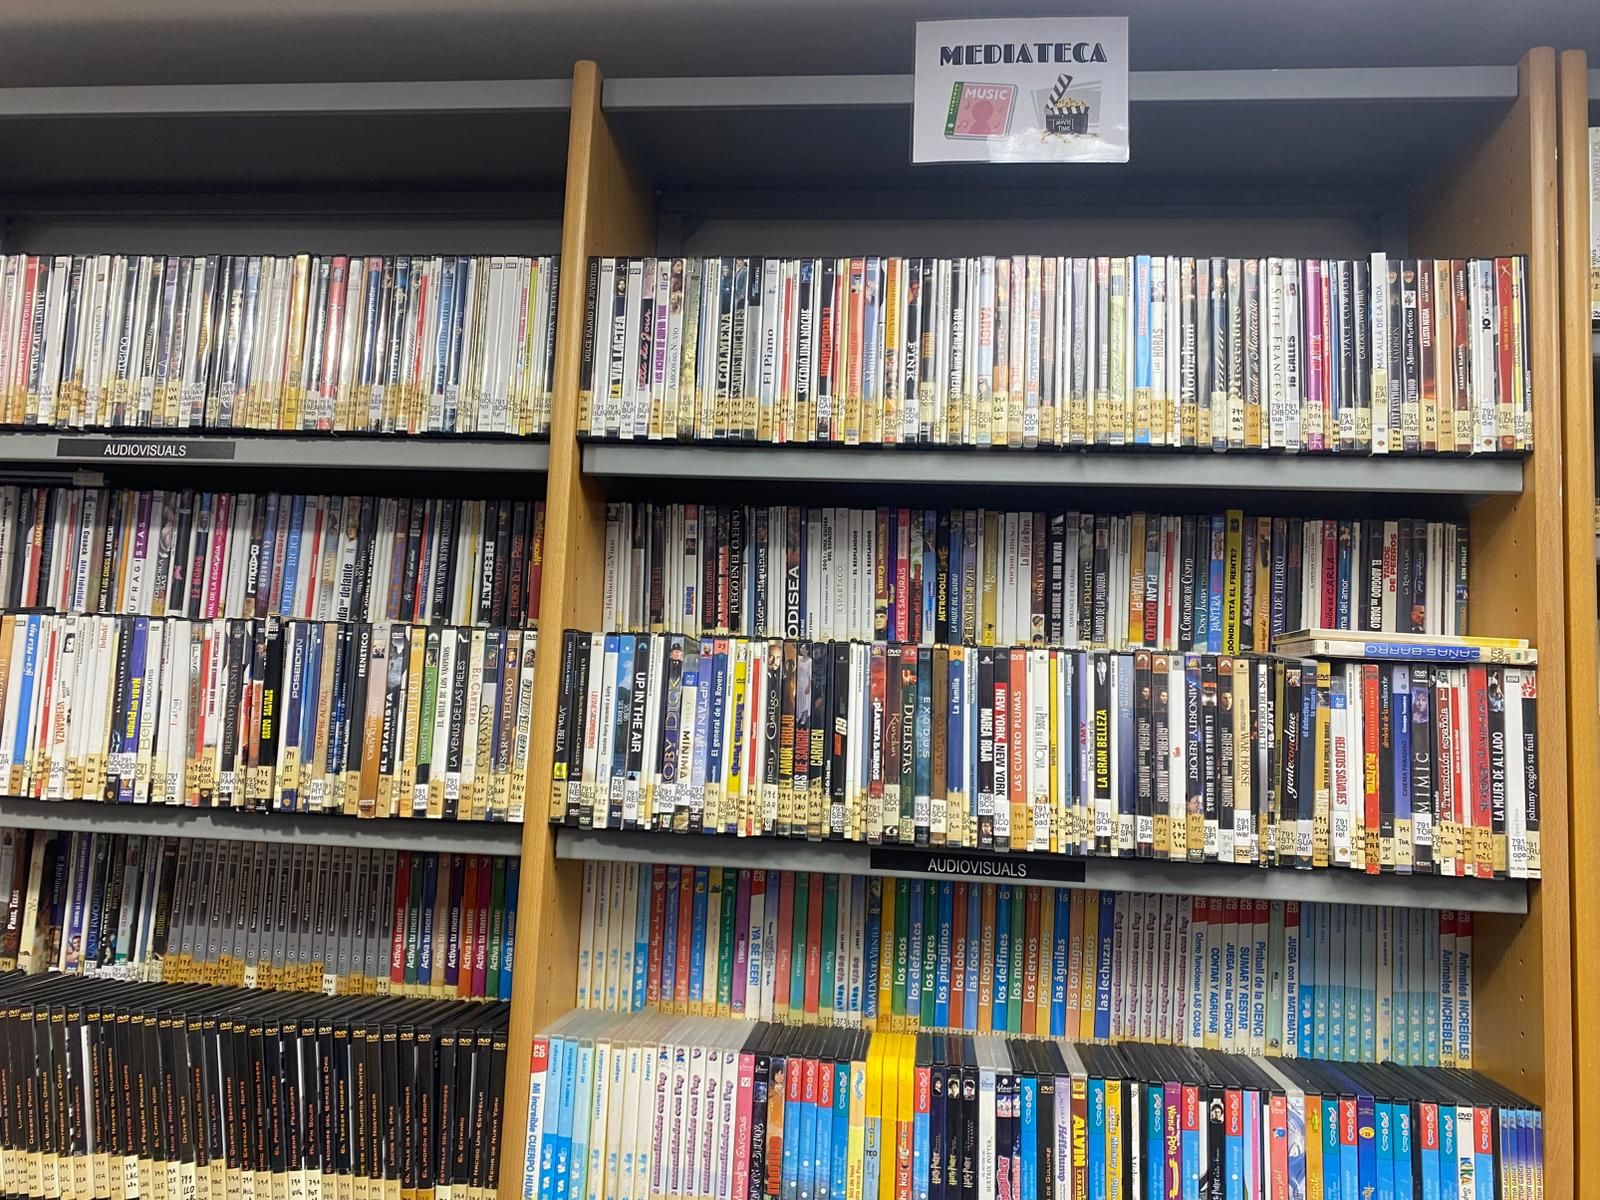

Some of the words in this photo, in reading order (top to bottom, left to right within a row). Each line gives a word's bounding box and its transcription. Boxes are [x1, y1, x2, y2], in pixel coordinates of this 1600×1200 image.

[940, 43, 1107, 66] MEDIATECA
[964, 86, 1008, 100] MUSIC
[734, 309, 744, 358] INOCENTES
[1153, 329, 1163, 357] HORAS
[717, 313, 730, 382] COLMENA
[763, 329, 773, 367] Piano
[800, 339, 809, 356] UNA
[1182, 324, 1195, 399] Modigliani
[733, 361, 742, 391] SANTOS
[797, 359, 808, 393] SUCEDIÓ
[104, 444, 186, 456] AUDIOVISUALS
[730, 511, 739, 548] CUERPO
[1021, 520, 1030, 534] Ryan
[1021, 546, 1030, 557] Hija
[247, 545, 259, 593] BABEL
[340, 564, 353, 597] delante
[1275, 555, 1284, 593] HIERRO
[896, 568, 905, 608] SAMURÁIS
[1097, 573, 1106, 599] PELUQUERA
[1146, 575, 1157, 601] PLAN
[1195, 588, 1207, 610] Juan
[788, 565, 799, 637] ODISEA
[963, 563, 974, 645] PERVERSIDAD
[1146, 603, 1156, 640] OCULTO
[1197, 614, 1206, 634] Don
[292, 638, 302, 698] POSEIDON
[456, 661, 465, 686] PIELES
[637, 672, 645, 688] UP
[263, 690, 273, 716] SALVAJE
[635, 691, 644, 703] IN
[665, 676, 680, 730] DICK
[55, 701, 64, 744] VENGANZA
[141, 712, 151, 750] Belle
[262, 719, 271, 739] GRUPO
[381, 693, 392, 752] PIANISTA
[633, 707, 643, 728] THE
[781, 715, 794, 745] BRUJO
[981, 708, 992, 736] MAREA
[1096, 710, 1107, 747] BELLEZA
[1440, 708, 1449, 749] española
[225, 709, 234, 754] PRESUNTO
[478, 705, 488, 767] CYRANO
[632, 734, 641, 752] AIR
[795, 728, 808, 760] SANGRE
[1493, 732, 1503, 754] LADO
[780, 748, 792, 775] AMOR
[811, 730, 824, 766] CARMEN
[981, 738, 992, 762] ROJA
[795, 762, 808, 772] DE
[1097, 750, 1107, 774] GRAN
[1493, 757, 1503, 767] AL
[1494, 769, 1503, 779] DE
[781, 778, 792, 788] EL
[1098, 777, 1107, 788] LA
[1416, 752, 1429, 814] MIMIC
[1439, 752, 1451, 807] Transición
[1525, 765, 1536, 791] cogió
[1494, 782, 1503, 808] MUJER
[1528, 794, 1537, 821] johnny
[1494, 811, 1504, 820] LA
[928, 858, 1026, 876] AUDIOVISUALS
[406, 944, 415, 968] Activa
[883, 931, 892, 969] leones
[897, 937, 906, 964] osos
[909, 923, 921, 979] elefantes
[925, 935, 936, 970] tigres
[938, 922, 950, 983] pingüinos
[954, 938, 964, 970] lobos
[968, 940, 978, 972] focas
[996, 933, 1007, 982] delfines
[1026, 938, 1036, 981] ciervos
[1239, 947, 1250, 980] SUMAR
[895, 967, 905, 984] los
[1099, 938, 1111, 990] lechuzas
[908, 983, 918, 1000] los
[924, 974, 933, 991] los
[937, 986, 946, 1003] los
[954, 974, 963, 991] los
[968, 976, 976, 992] las
[996, 986, 1005, 1003] los
[1025, 985, 1035, 1002] los
[1098, 994, 1108, 1010] las
[1238, 994, 1248, 1029] RESTAR
[1073, 1115, 1084, 1166] ALVIN
